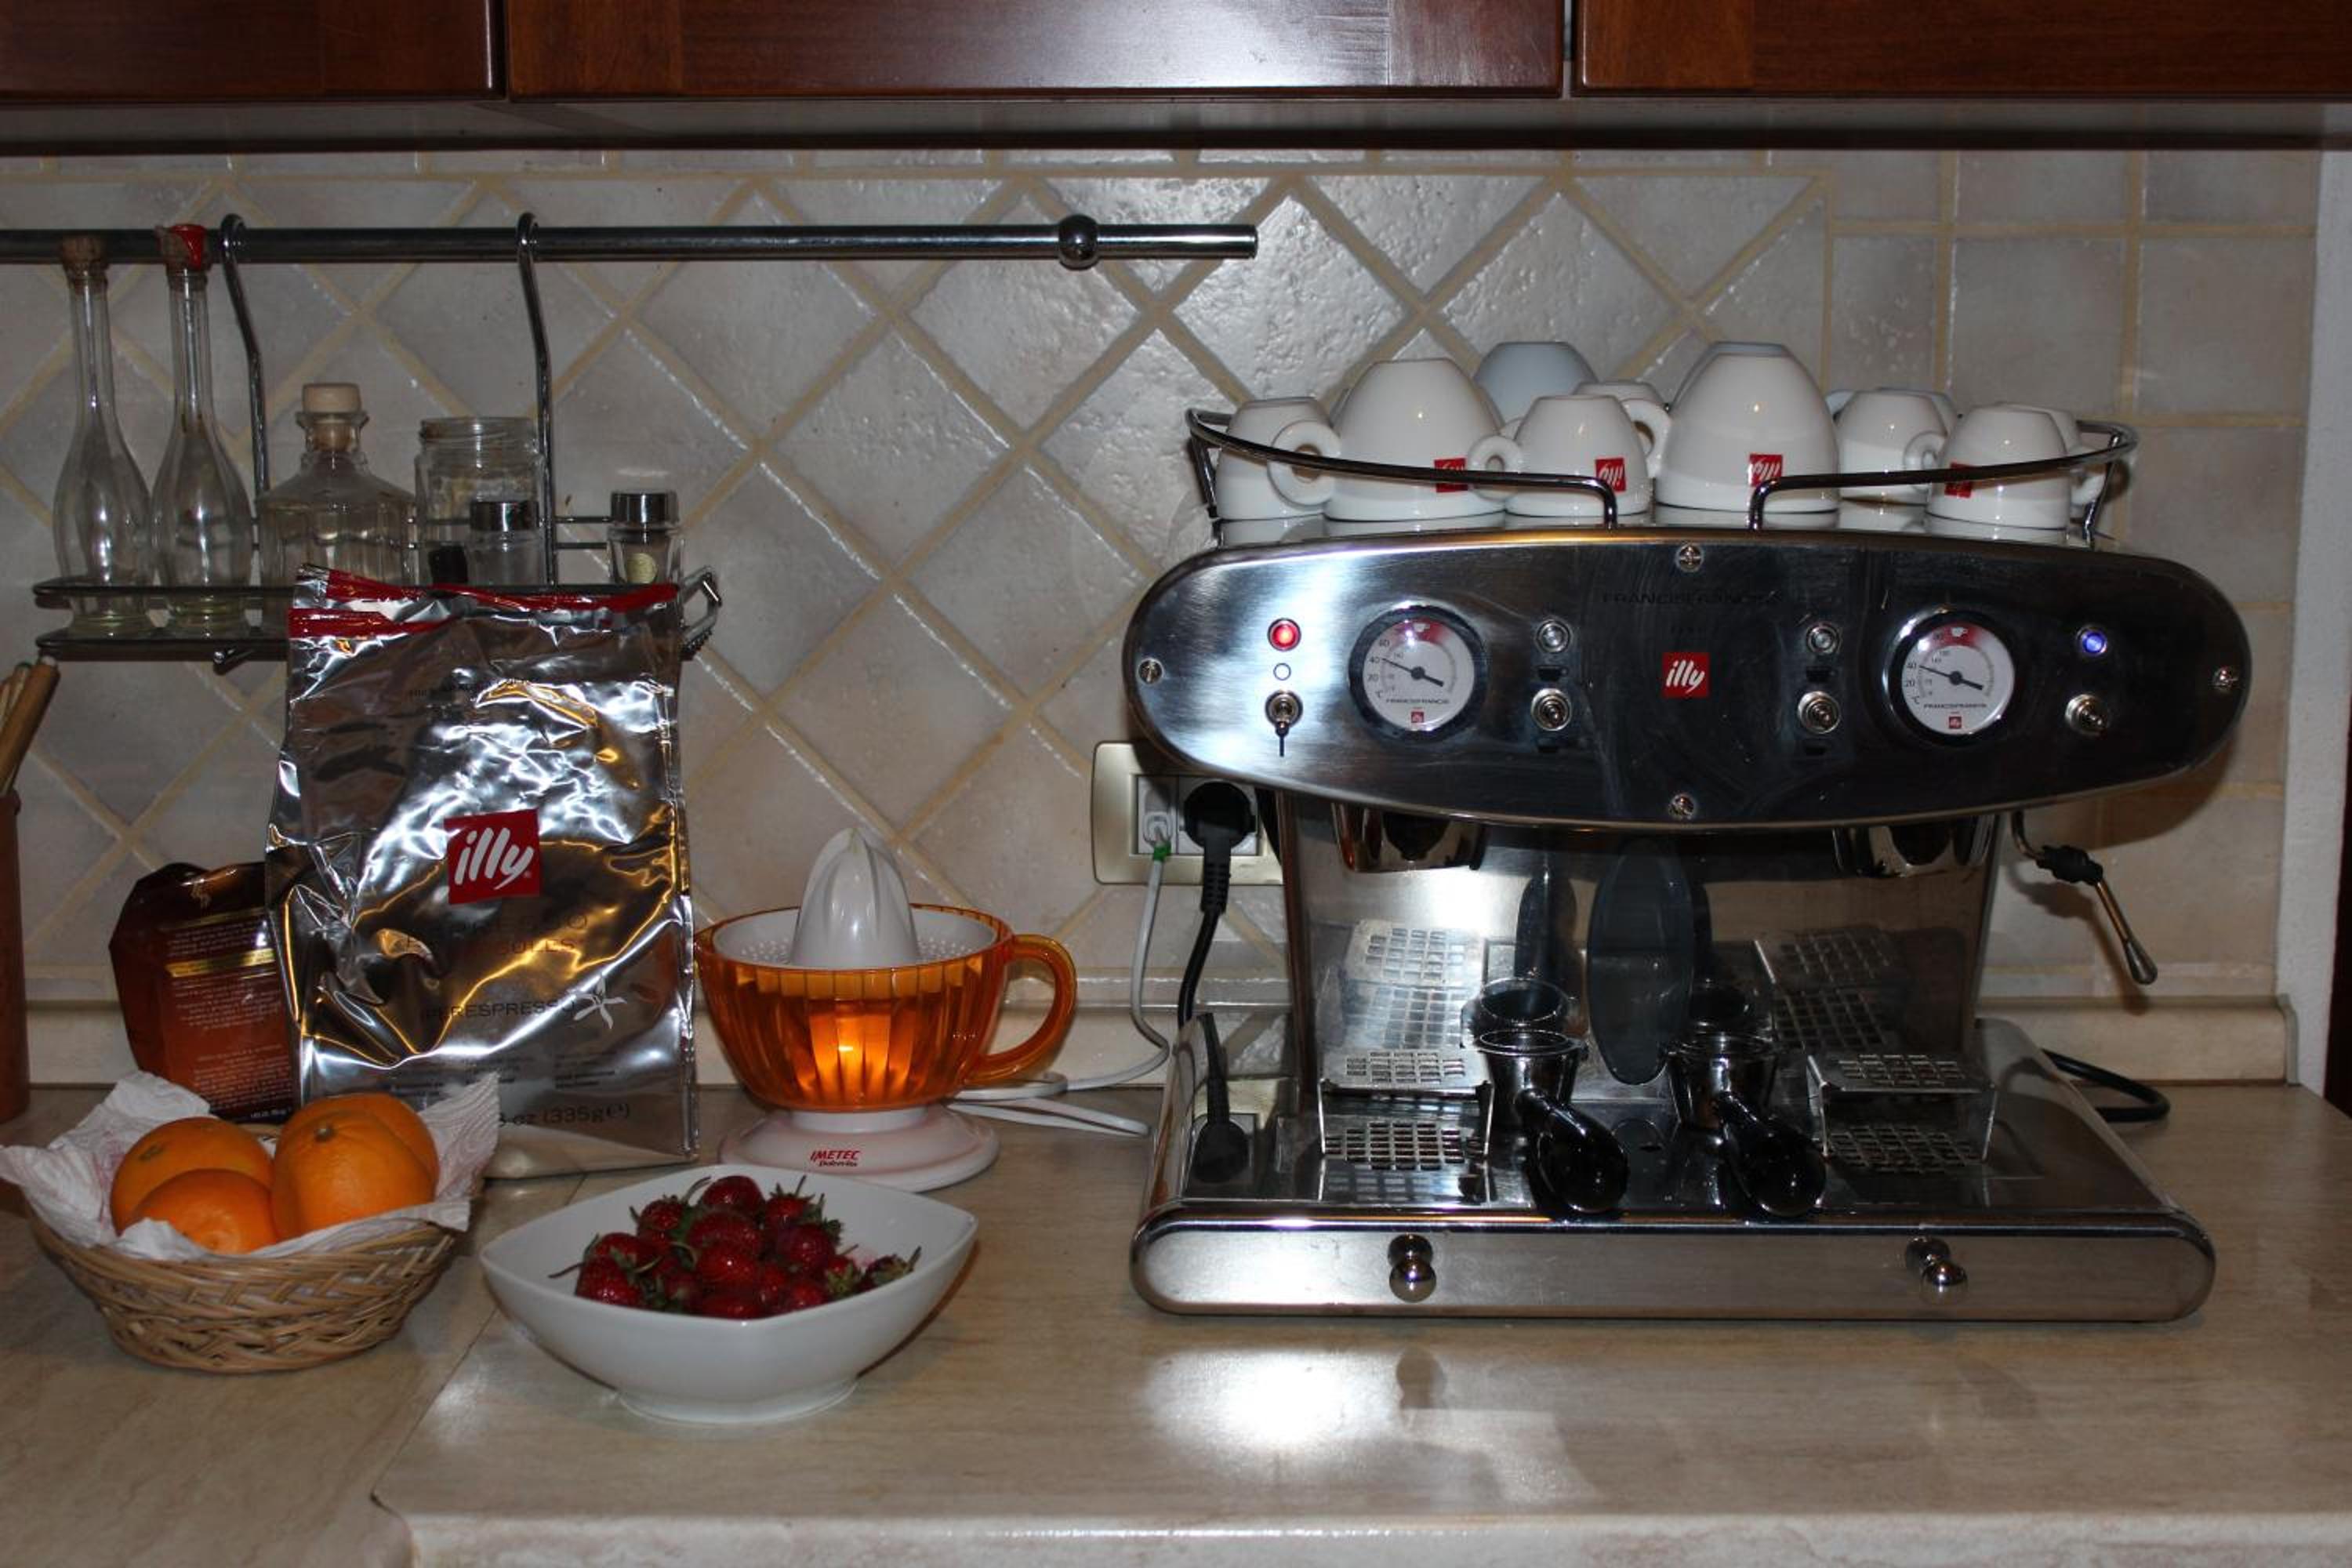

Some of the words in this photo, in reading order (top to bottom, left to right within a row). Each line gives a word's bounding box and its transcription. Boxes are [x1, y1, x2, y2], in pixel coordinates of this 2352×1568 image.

[1666, 659, 1706, 694] illy
[455, 827, 535, 891] illy
[810, 1149, 860, 1162] IMETEC
